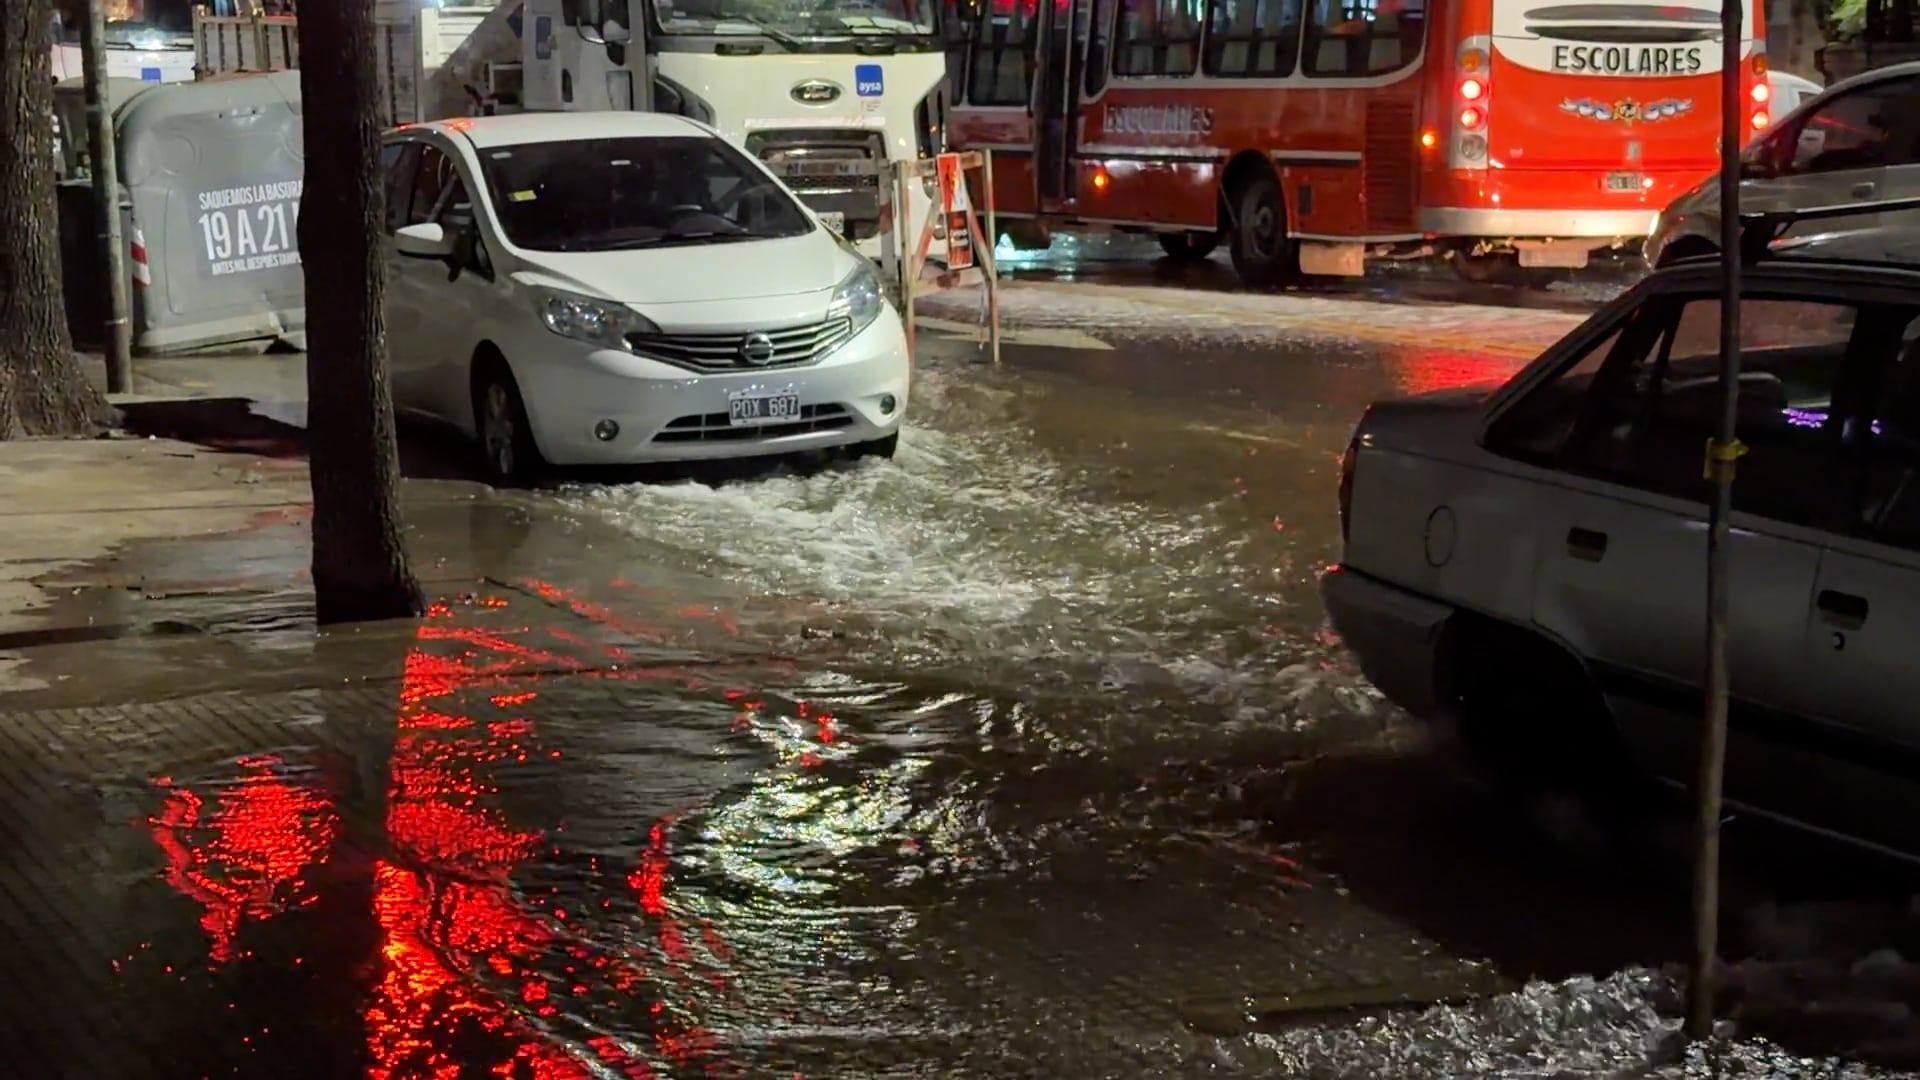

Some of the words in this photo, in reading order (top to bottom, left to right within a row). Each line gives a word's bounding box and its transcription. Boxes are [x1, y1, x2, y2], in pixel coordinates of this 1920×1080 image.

[1552, 45, 1701, 75] ESCOLARES
[858, 82, 882, 94] aysa
[198, 186, 254, 210] SAQUEMOS
[253, 184, 266, 203] LA
[198, 211, 232, 260] 19
[238, 208, 258, 256] A
[258, 203, 289, 252] 21
[731, 399, 760, 419] POX
[769, 396, 796, 416] 687
